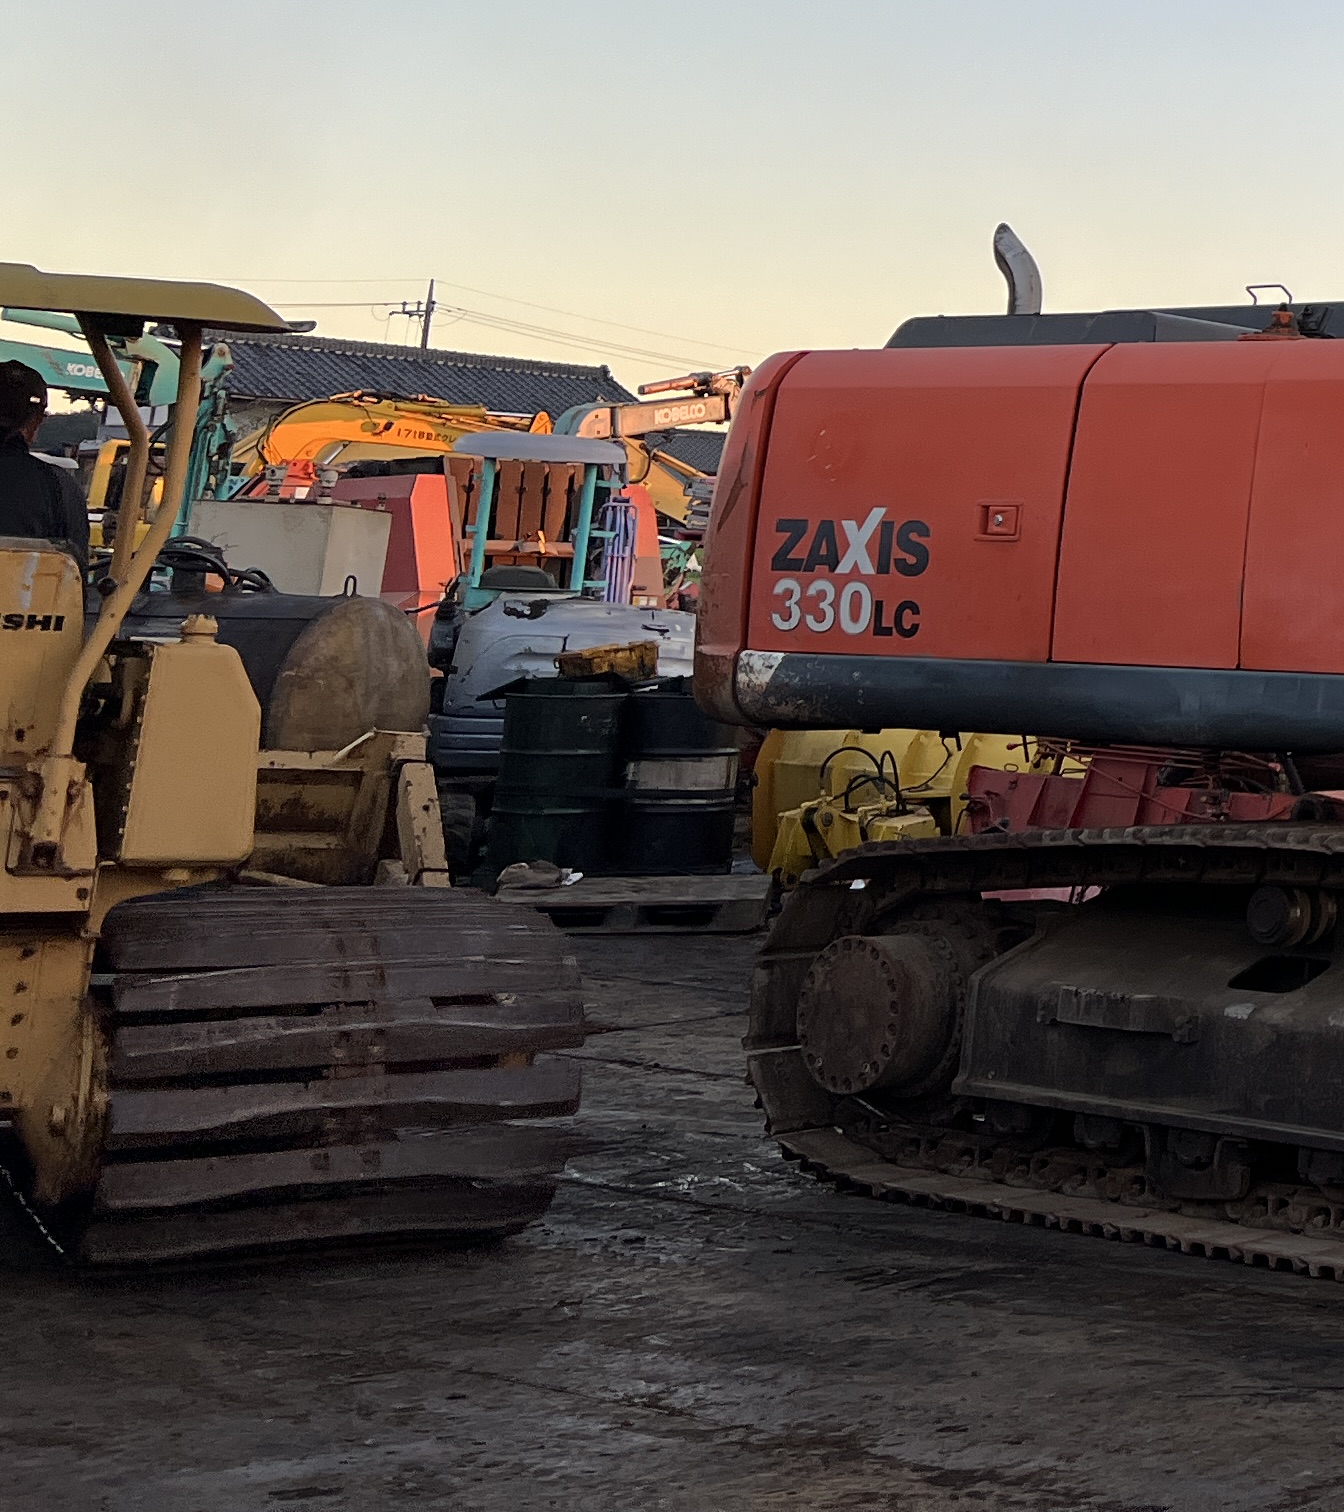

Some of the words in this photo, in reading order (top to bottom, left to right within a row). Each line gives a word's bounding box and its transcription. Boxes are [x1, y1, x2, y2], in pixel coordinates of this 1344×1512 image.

[654, 403, 706, 425] KOBELCO
[771, 506, 931, 577] ZAXIS
[0, 613, 65, 632] SHI
